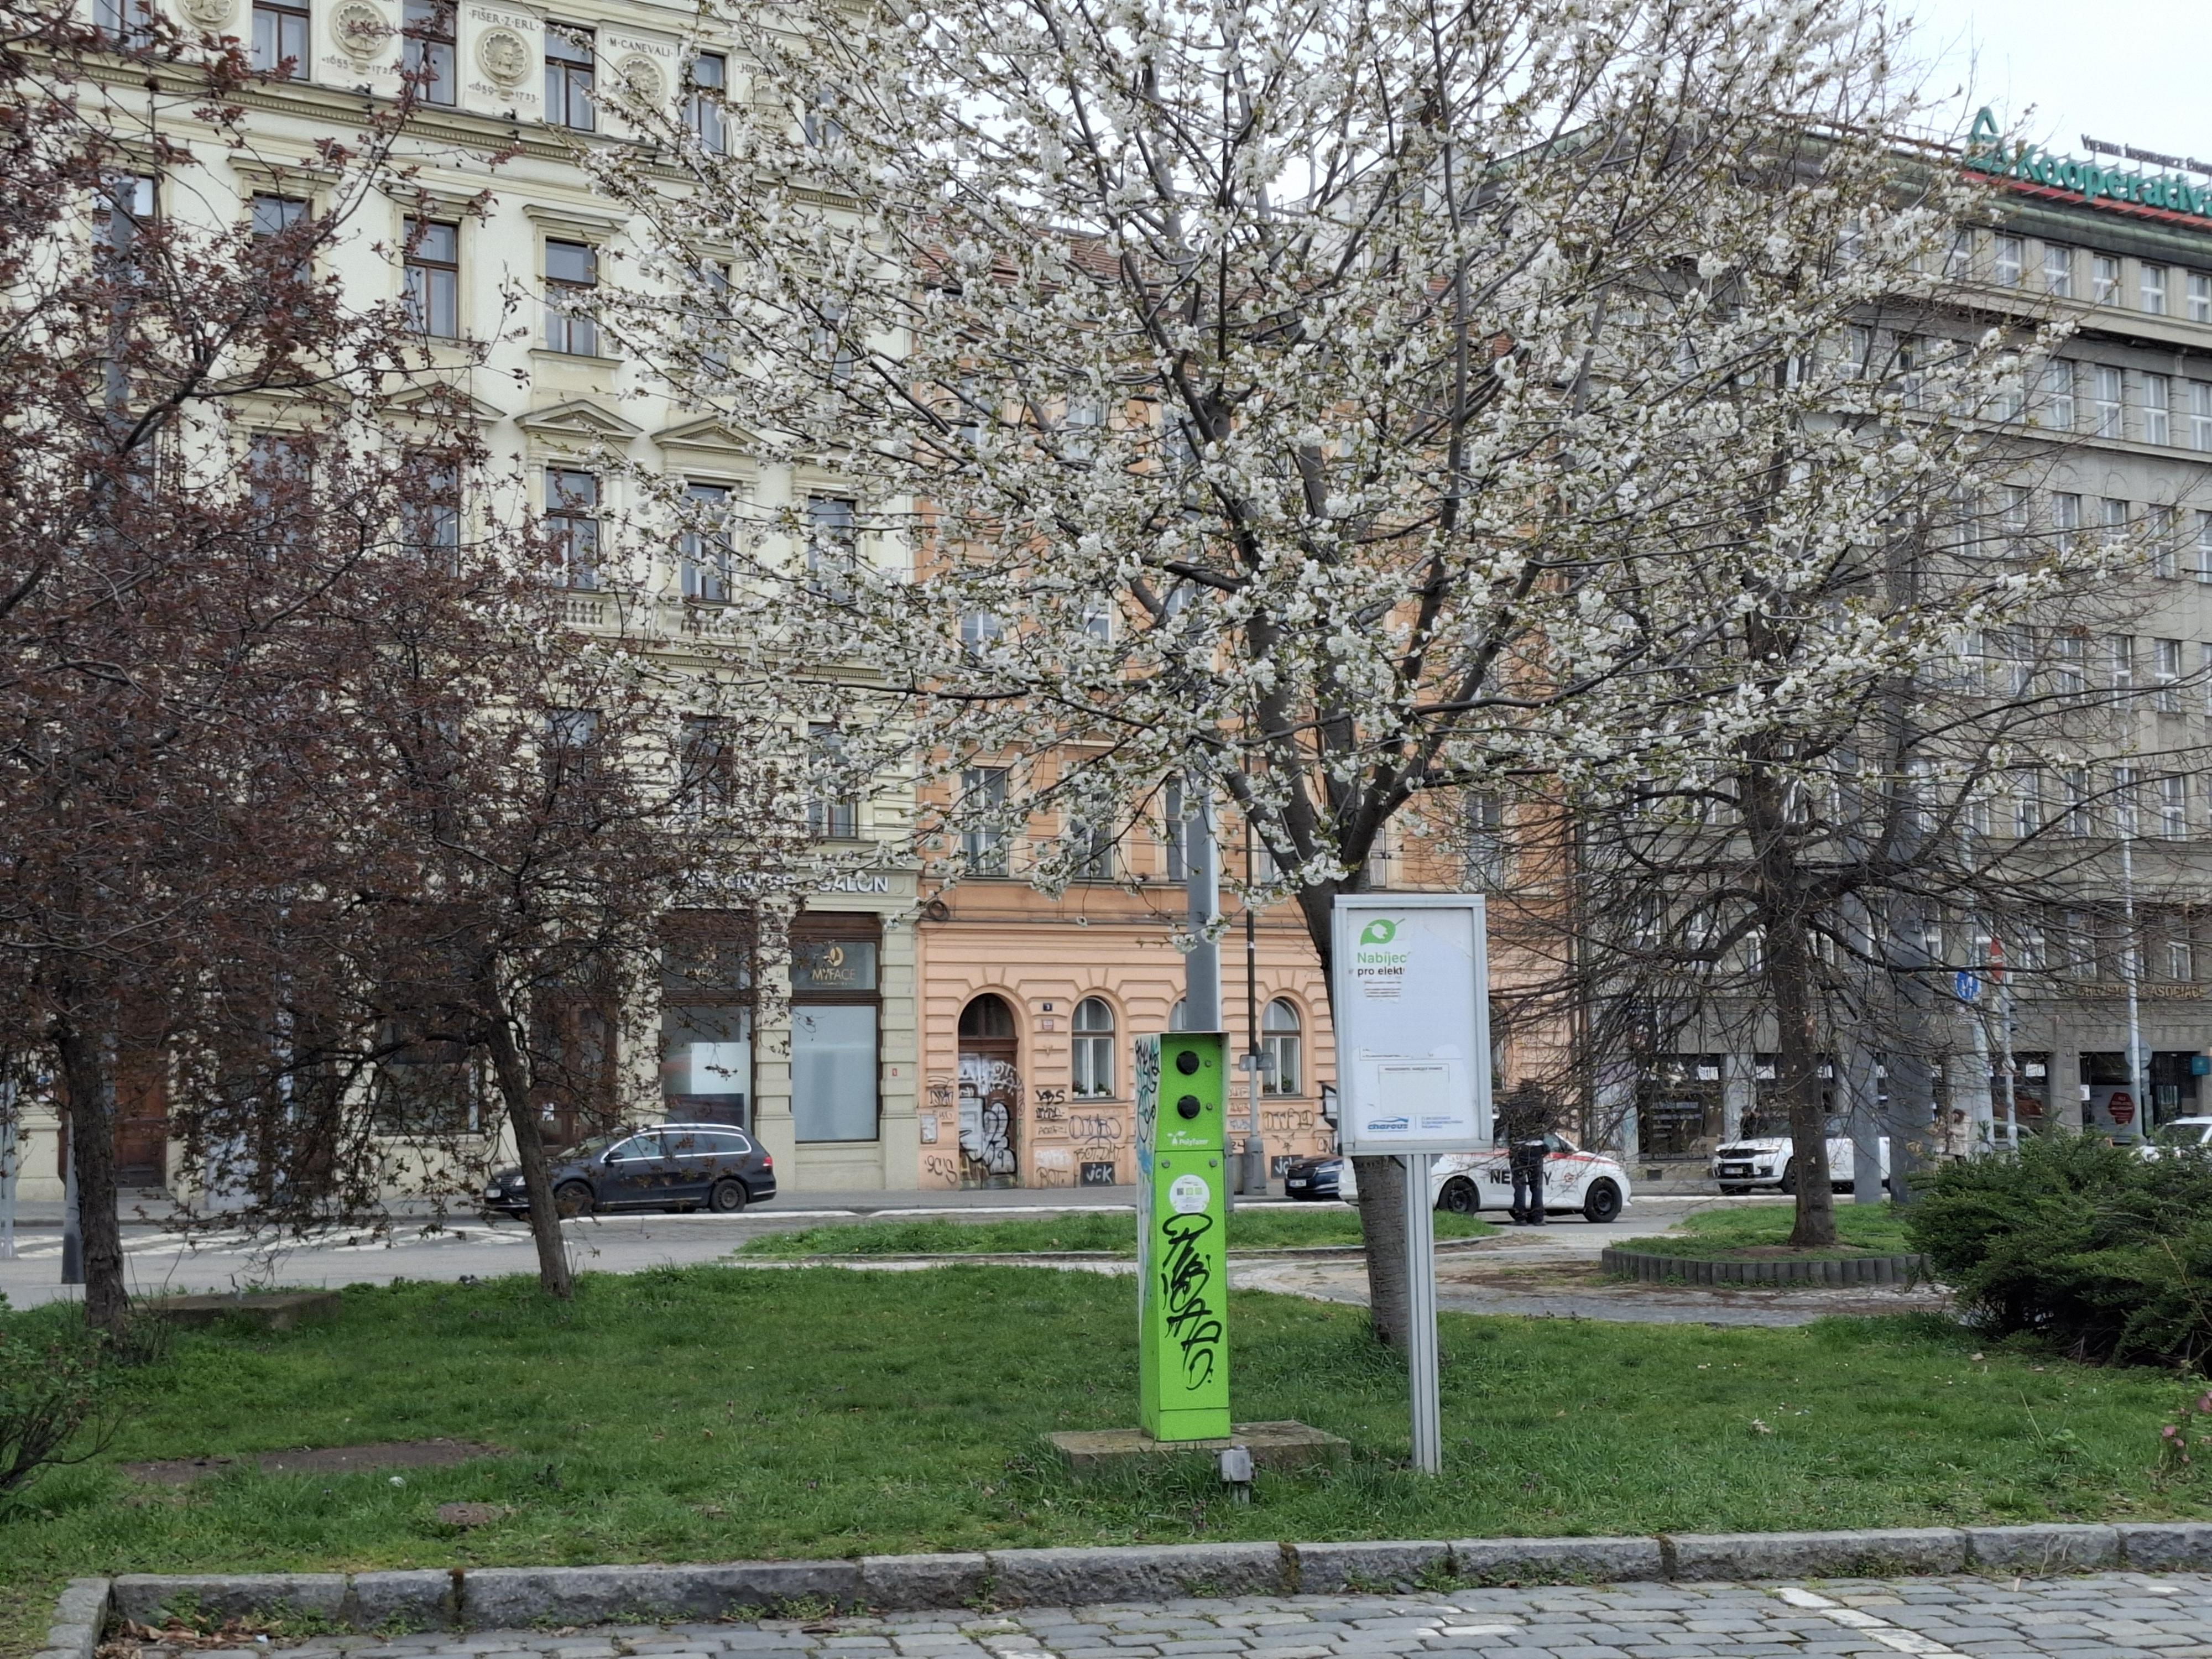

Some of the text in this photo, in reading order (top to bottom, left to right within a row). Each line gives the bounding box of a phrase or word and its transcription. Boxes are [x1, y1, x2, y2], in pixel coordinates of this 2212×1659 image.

[817, 876, 889, 893] SALON
[1357, 951, 1407, 966] Nabíjec
[811, 968, 855, 981] MYFACE
[1358, 968, 1375, 978] pro
